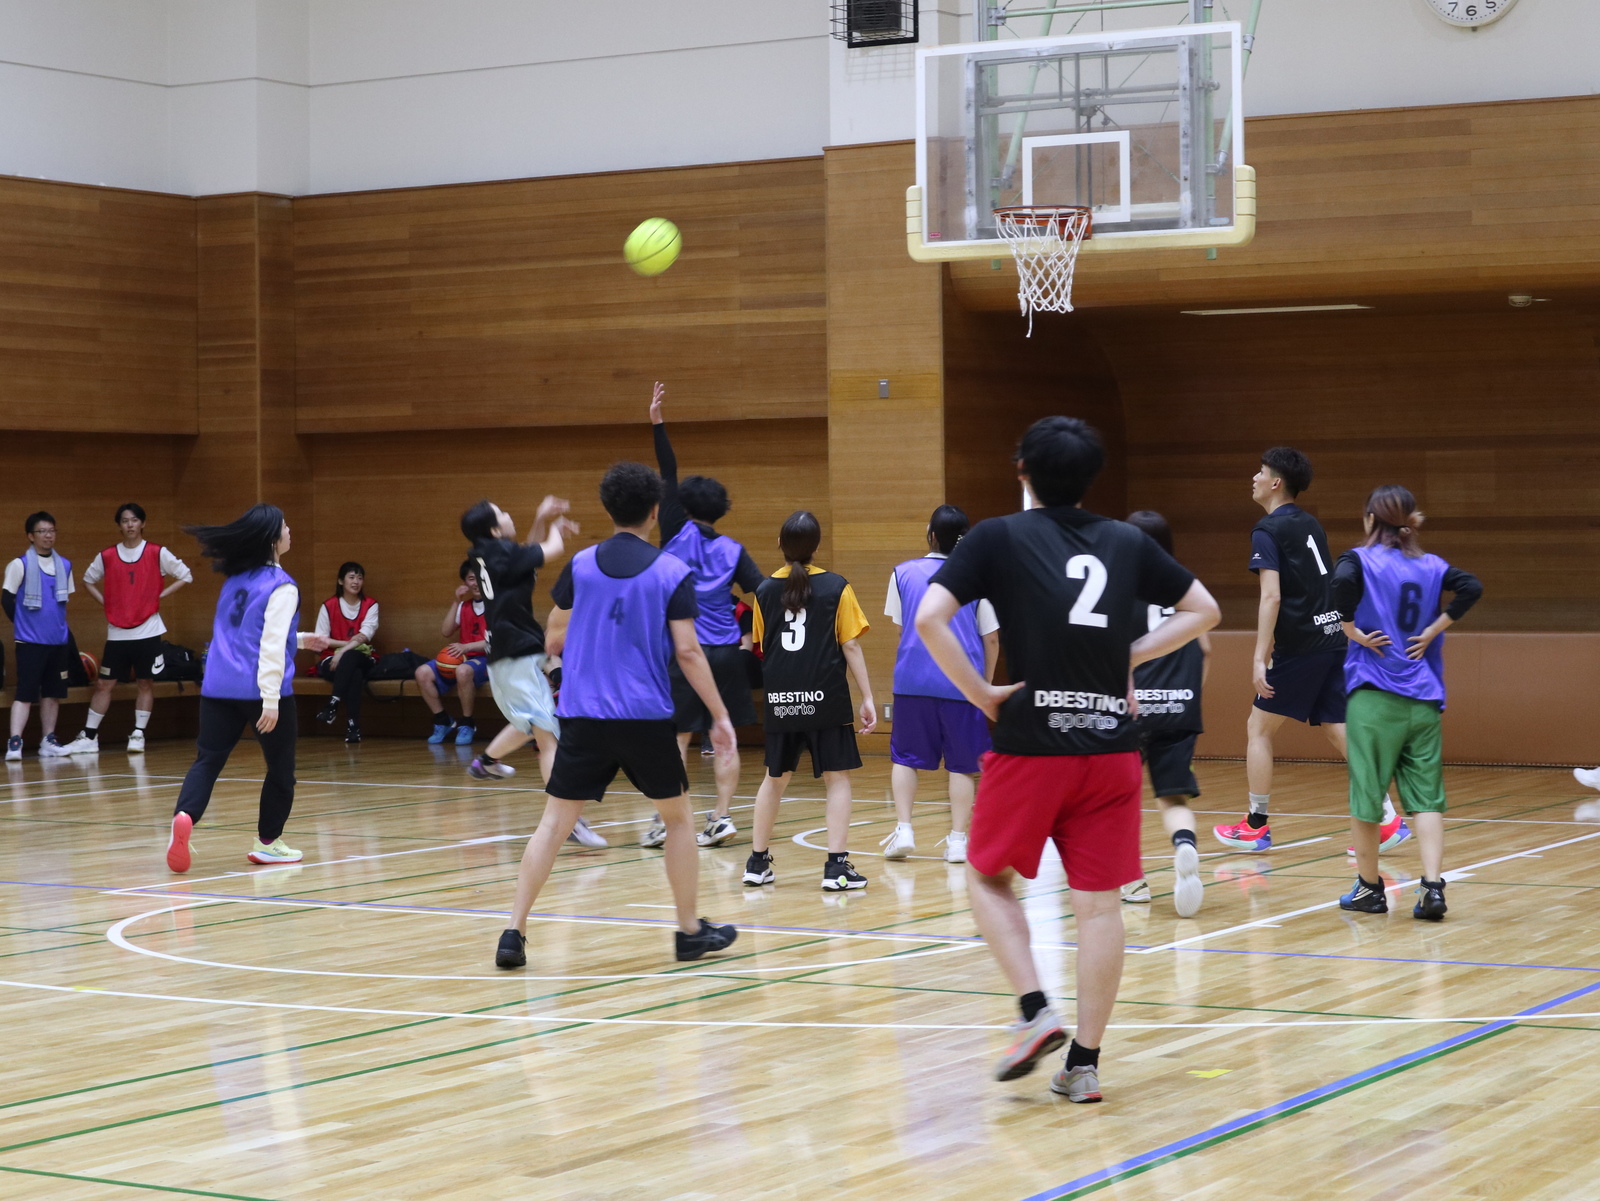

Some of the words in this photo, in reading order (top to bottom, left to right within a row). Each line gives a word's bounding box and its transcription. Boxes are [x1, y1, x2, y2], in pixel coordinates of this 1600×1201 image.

[1448, 2, 1458, 12] 7
[1466, 5, 1477, 16] 6
[1486, 0, 1496, 8] 5
[1306, 534, 1328, 575] 1
[127, 571, 135, 585] 1
[1066, 554, 1108, 628] 2
[229, 588, 248, 627] 3
[608, 597, 625, 625] 4
[1397, 581, 1422, 632] 6
[472, 622, 480, 635] 2
[781, 607, 807, 651] 3
[774, 703, 816, 719] sporto
[1047, 712, 1119, 733] sporto
